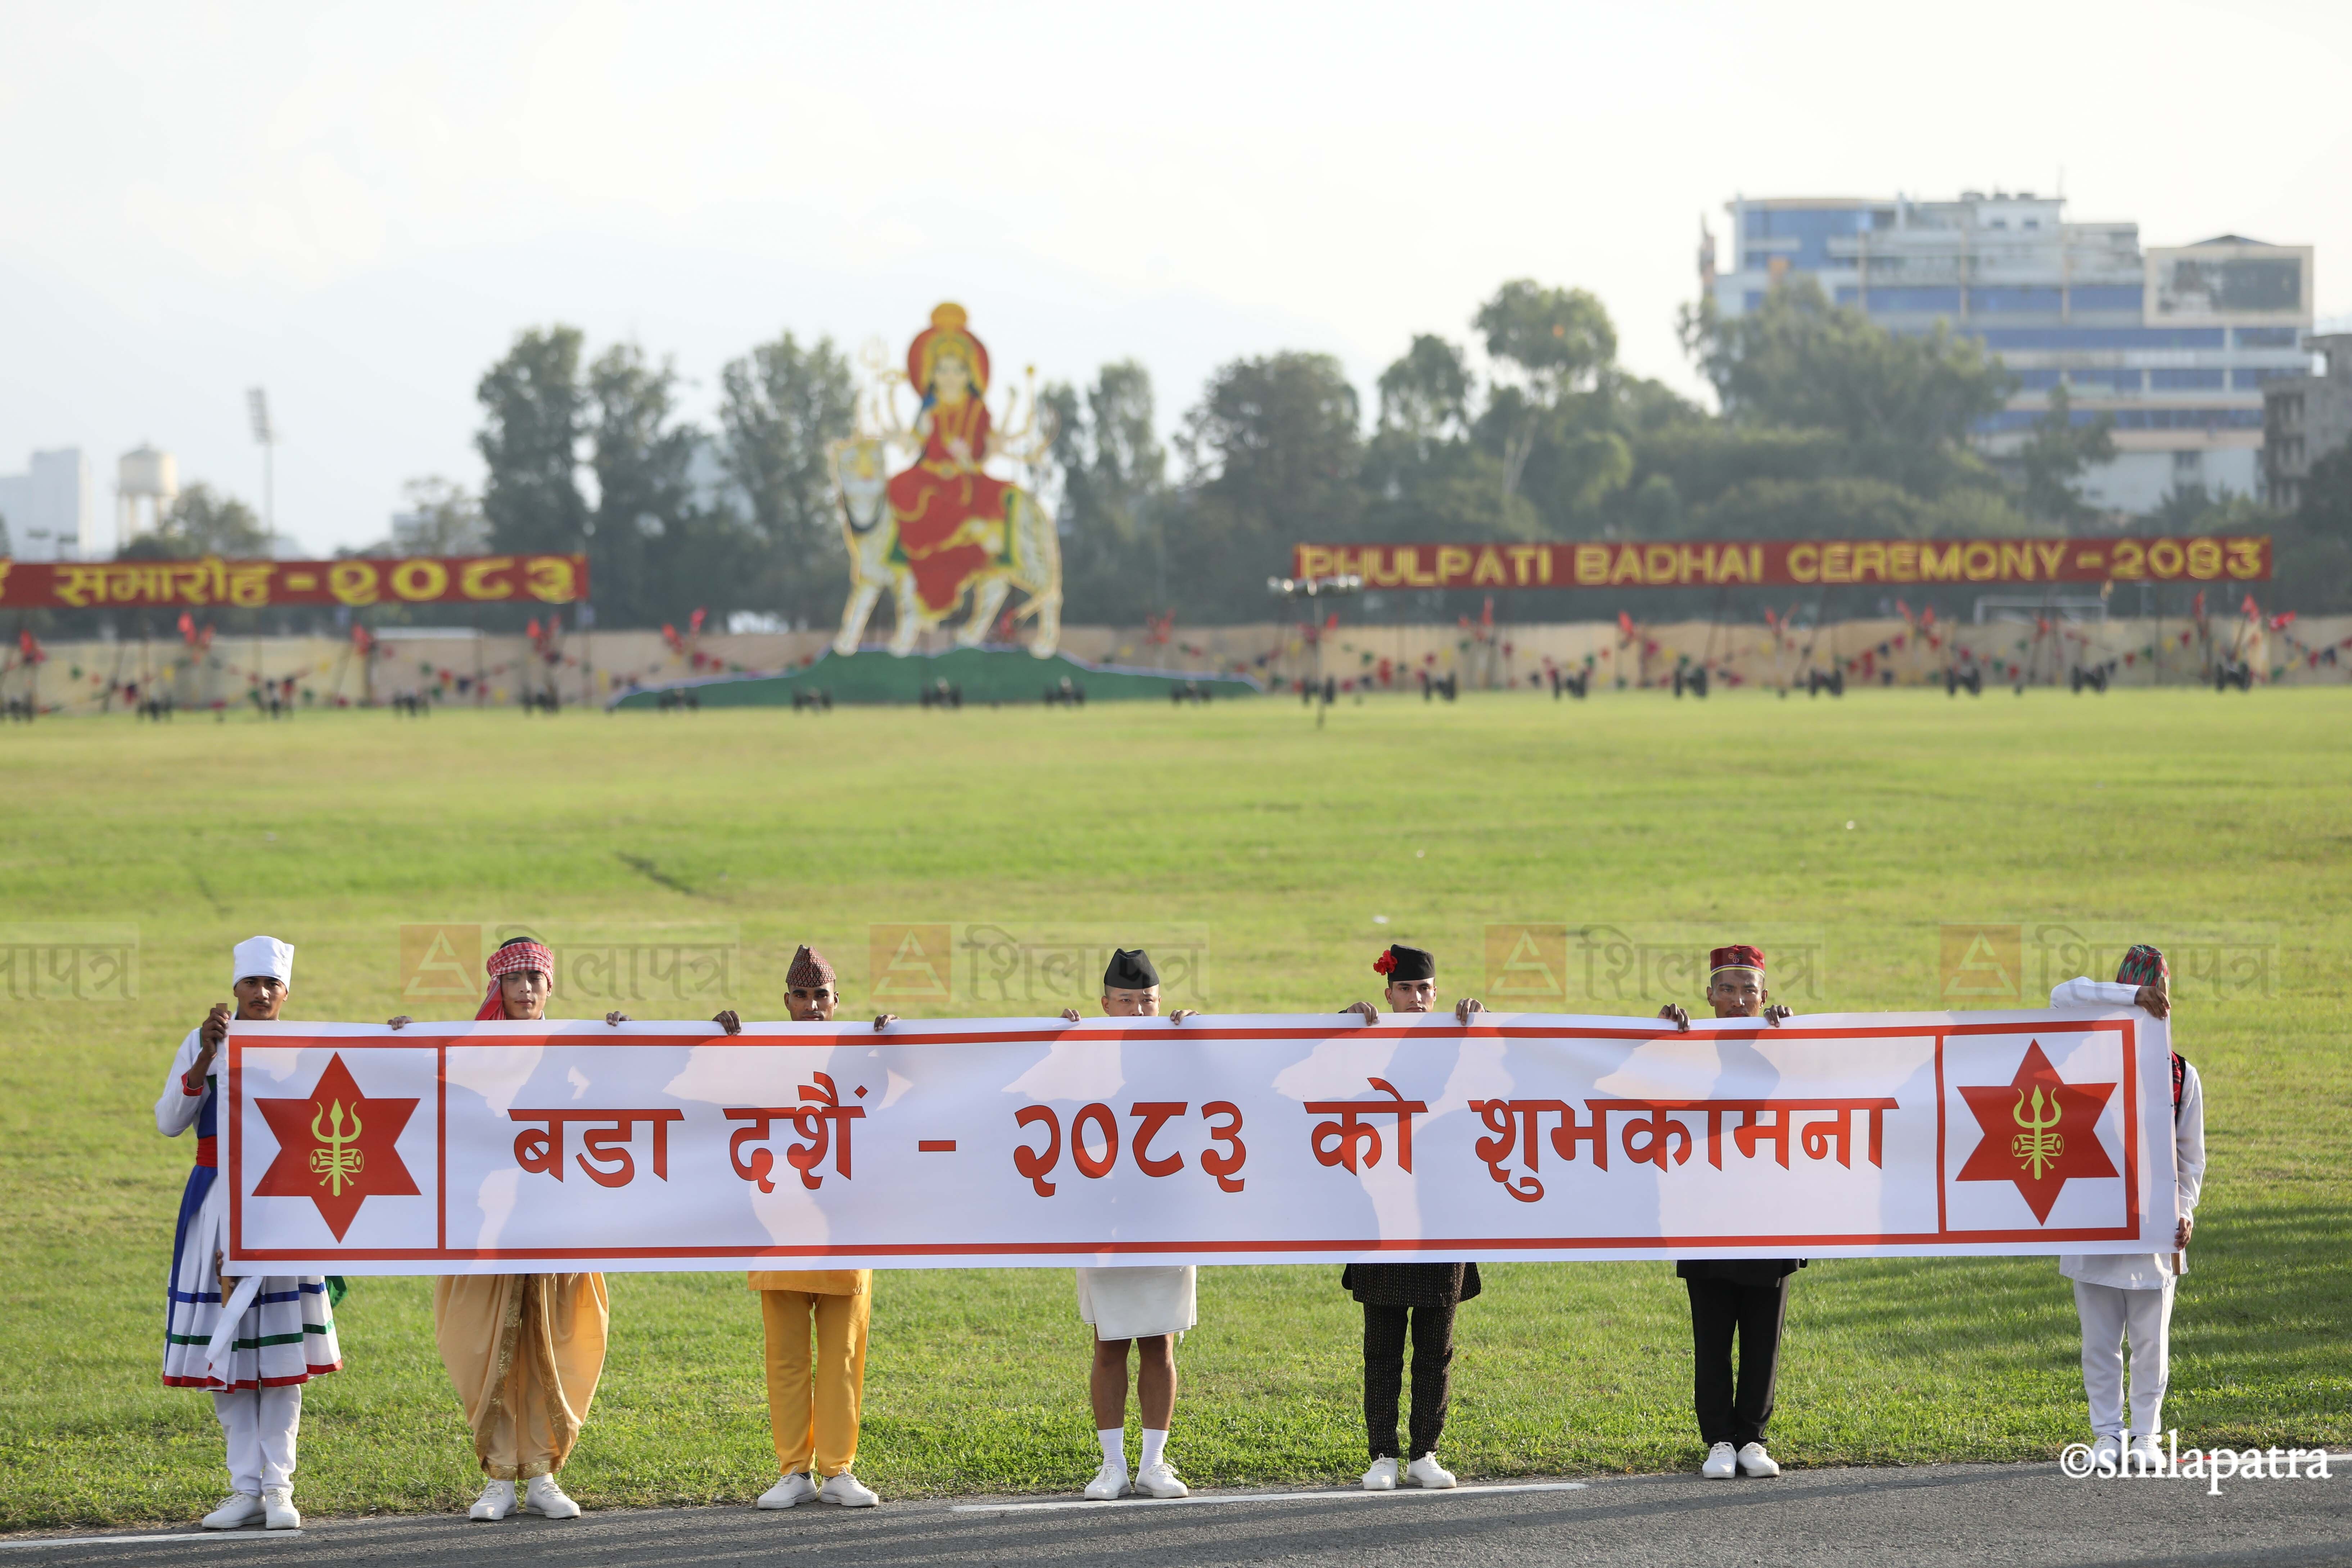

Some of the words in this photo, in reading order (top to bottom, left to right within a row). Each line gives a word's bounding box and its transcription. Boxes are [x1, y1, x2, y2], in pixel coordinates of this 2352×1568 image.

[1299, 544, 1553, 587] PHULPATI
[1574, 543, 1764, 586] BADHAI
[1786, 540, 2068, 583] CEREMONY
[508, 1109, 685, 1188] बडा
[723, 1071, 868, 1193] दशैं
[918, 1140, 956, 1152] -
[1014, 1101, 1246, 1197] २०८३
[1303, 1077, 1428, 1175] को
[1467, 1098, 1900, 1203] शुभकामना
